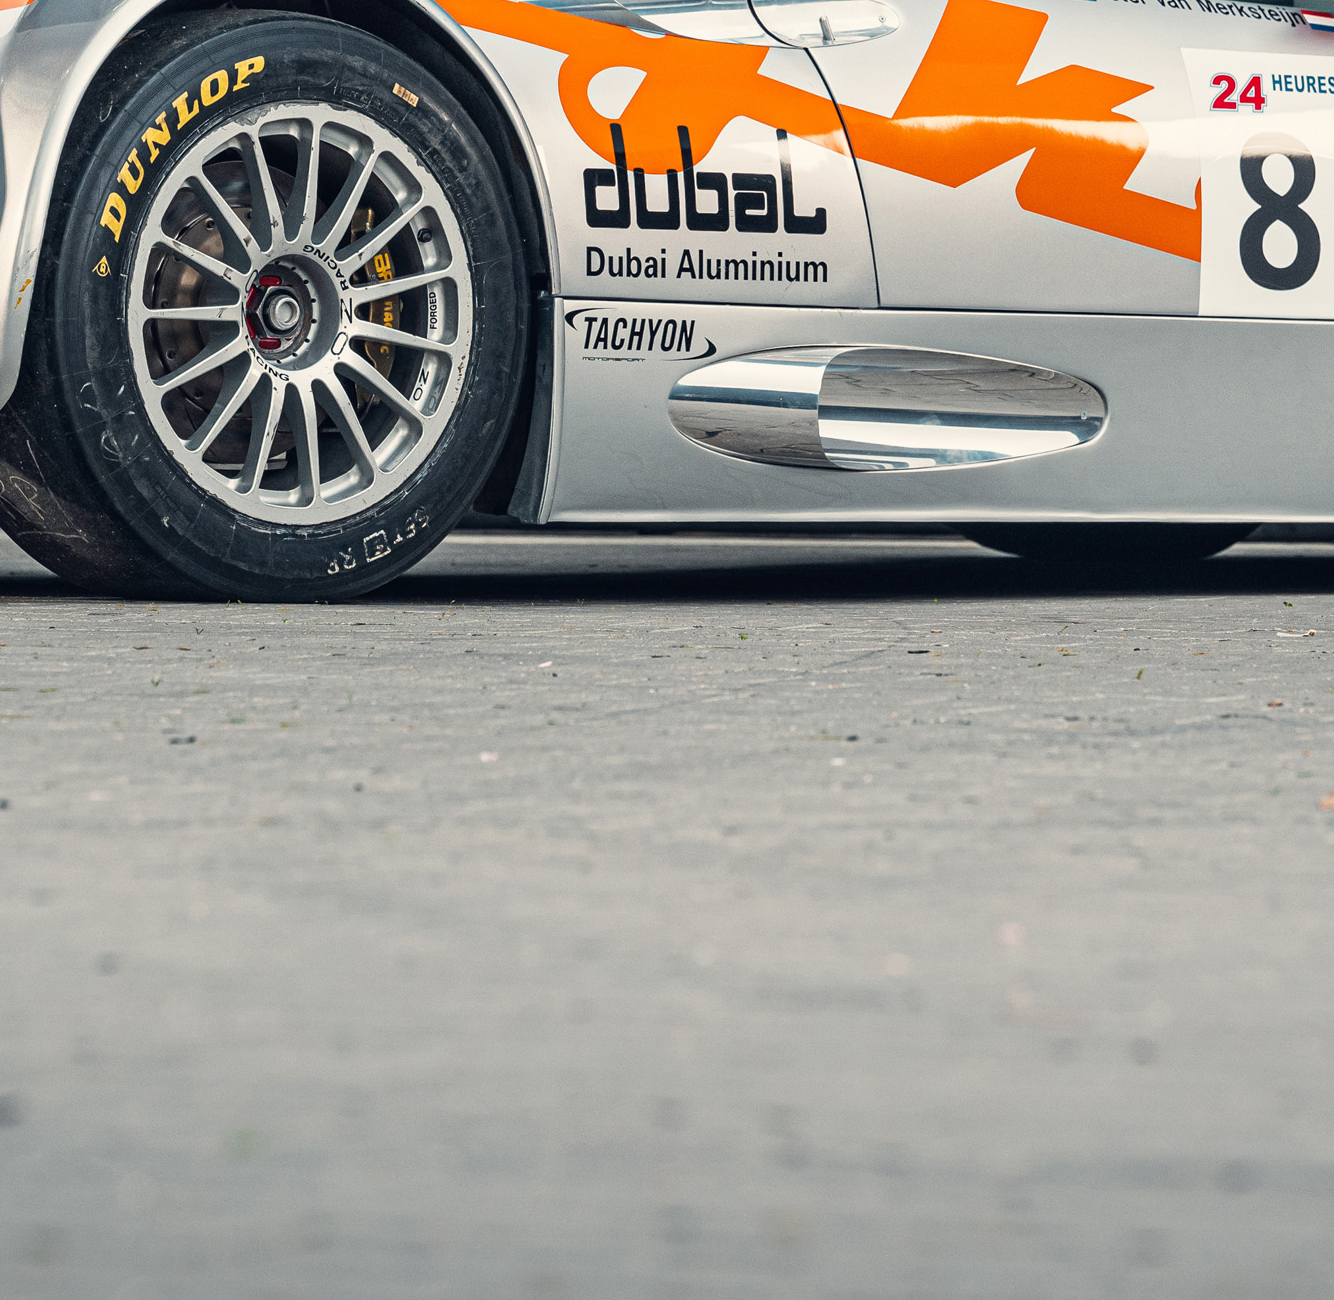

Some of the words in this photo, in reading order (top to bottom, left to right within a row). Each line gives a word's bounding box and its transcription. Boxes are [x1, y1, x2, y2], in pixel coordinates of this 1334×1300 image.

[1210, 73, 1267, 113] 24
[99, 55, 266, 244] DUNLOP
[302, 244, 350, 292] RACING
[586, 246, 667, 279] Dubai
[676, 248, 828, 283] Aluminium
[428, 291, 438, 330] FORGED
[583, 316, 696, 352] TACHYON
